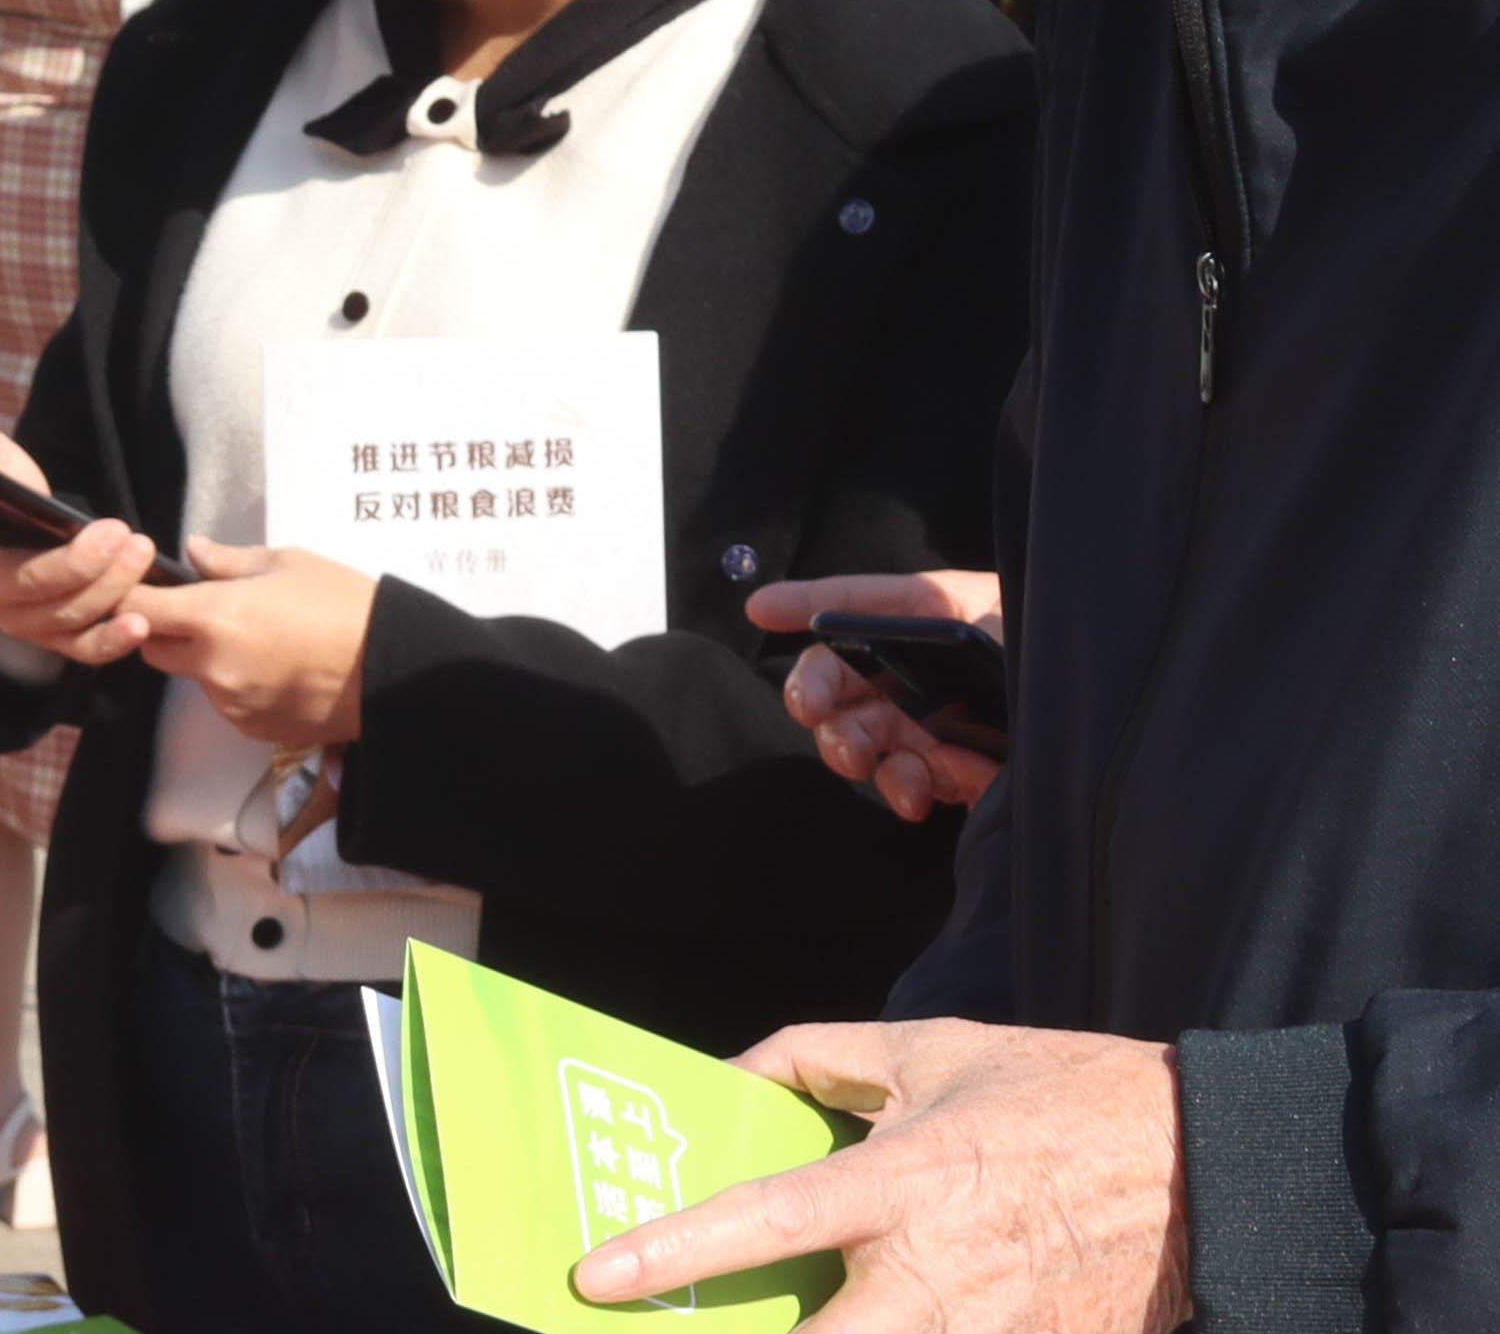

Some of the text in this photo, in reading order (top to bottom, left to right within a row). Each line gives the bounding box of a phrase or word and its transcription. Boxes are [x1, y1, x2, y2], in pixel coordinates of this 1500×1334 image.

[351, 436, 577, 475] 推进节粮减损
[353, 486, 578, 524] 反对粮食浪费
[425, 547, 509, 575] 宣传册
